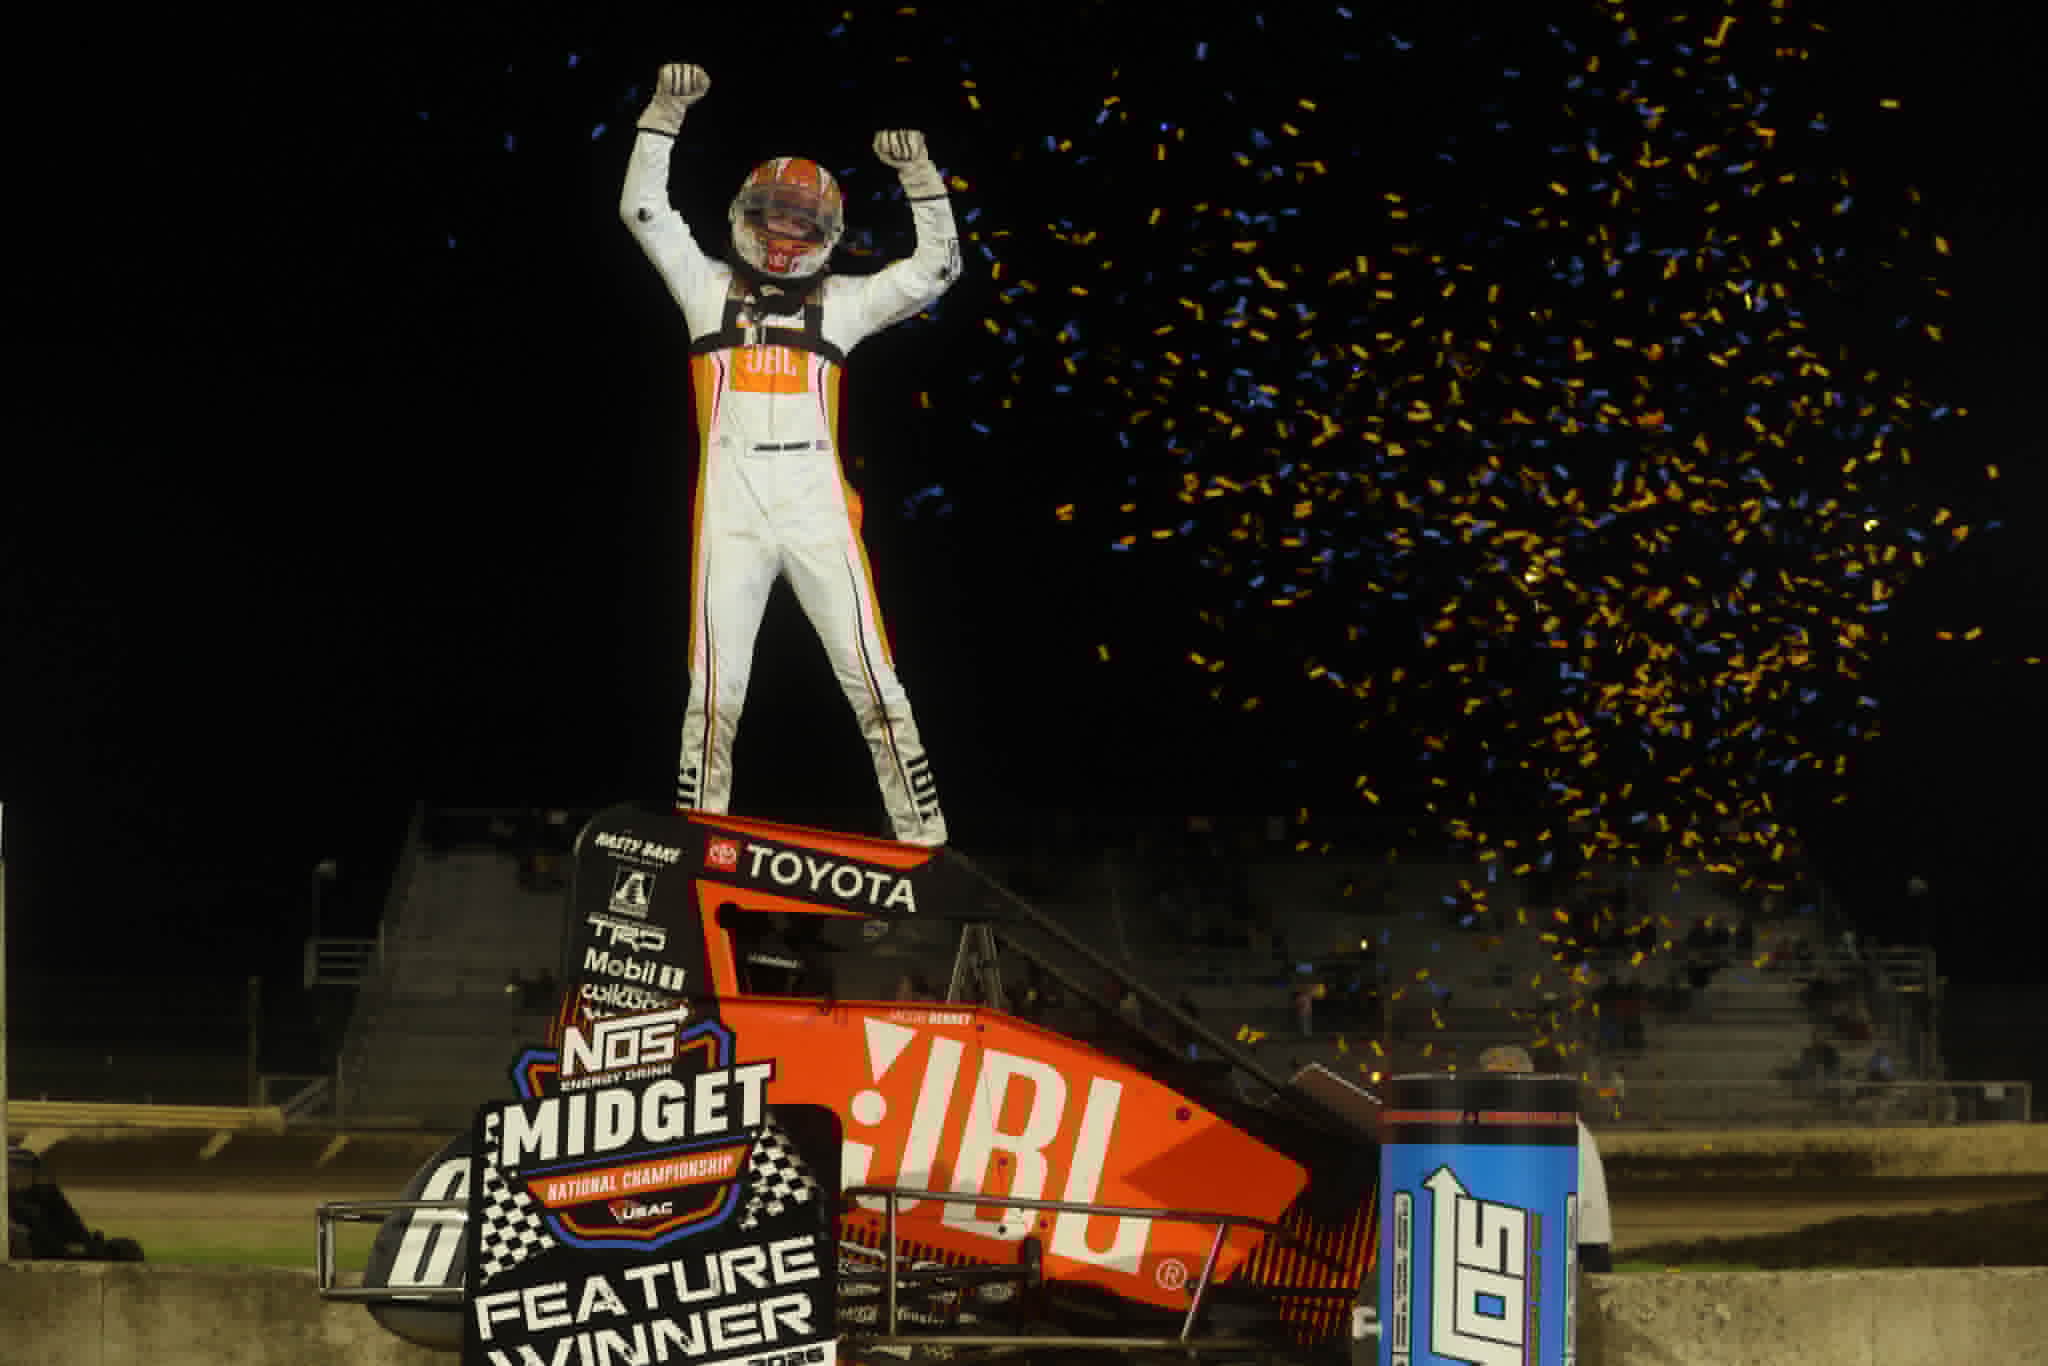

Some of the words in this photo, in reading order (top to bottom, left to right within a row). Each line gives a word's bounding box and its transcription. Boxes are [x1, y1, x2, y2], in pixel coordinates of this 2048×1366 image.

[747, 844, 917, 912] TOYOTA
[583, 947, 657, 985] Mobil
[560, 1005, 688, 1075] NOS
[503, 1063, 772, 1167] MIDGET
[546, 1173, 618, 1202] NATIONAL
[475, 1234, 821, 1341] FEATURE
